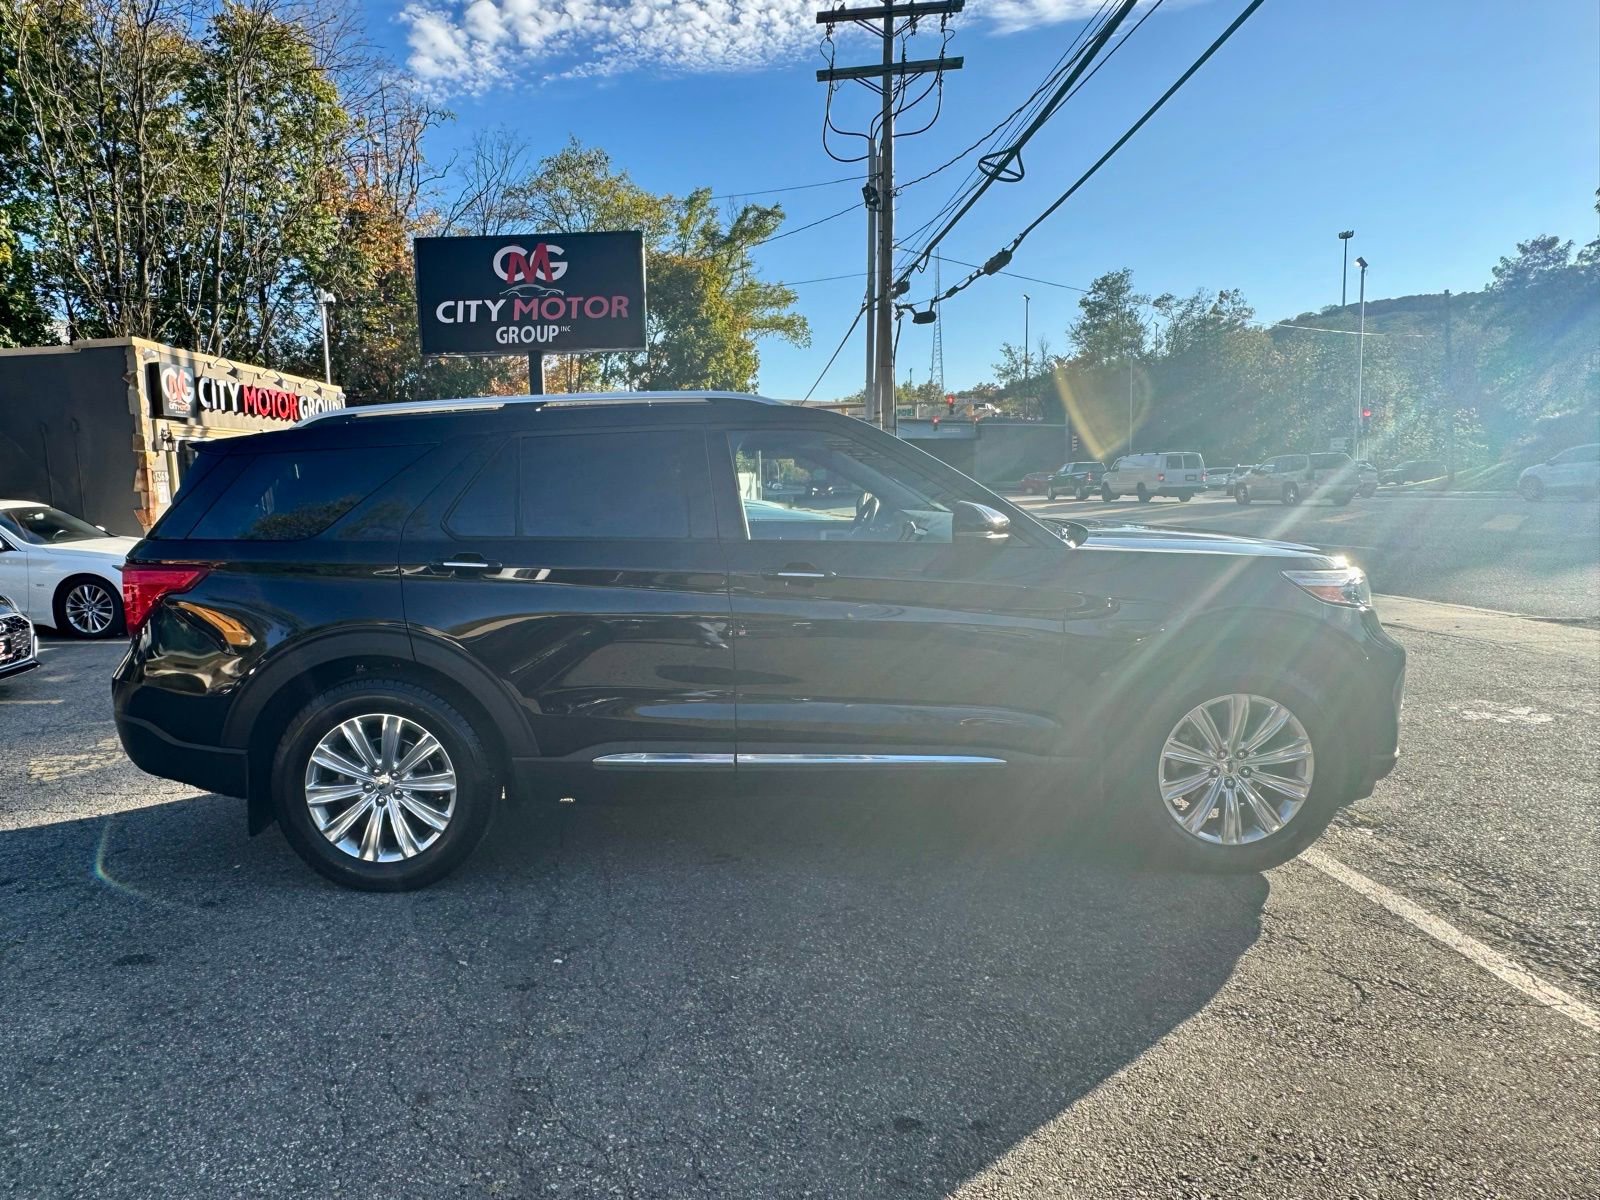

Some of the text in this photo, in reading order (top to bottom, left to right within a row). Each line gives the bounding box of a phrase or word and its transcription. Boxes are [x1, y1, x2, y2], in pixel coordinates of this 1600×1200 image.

[436, 296, 629, 323] CITY MOTOR
[495, 325, 559, 344] GROUP
[198, 377, 240, 412] CITY
[243, 385, 298, 420] MOTOR
